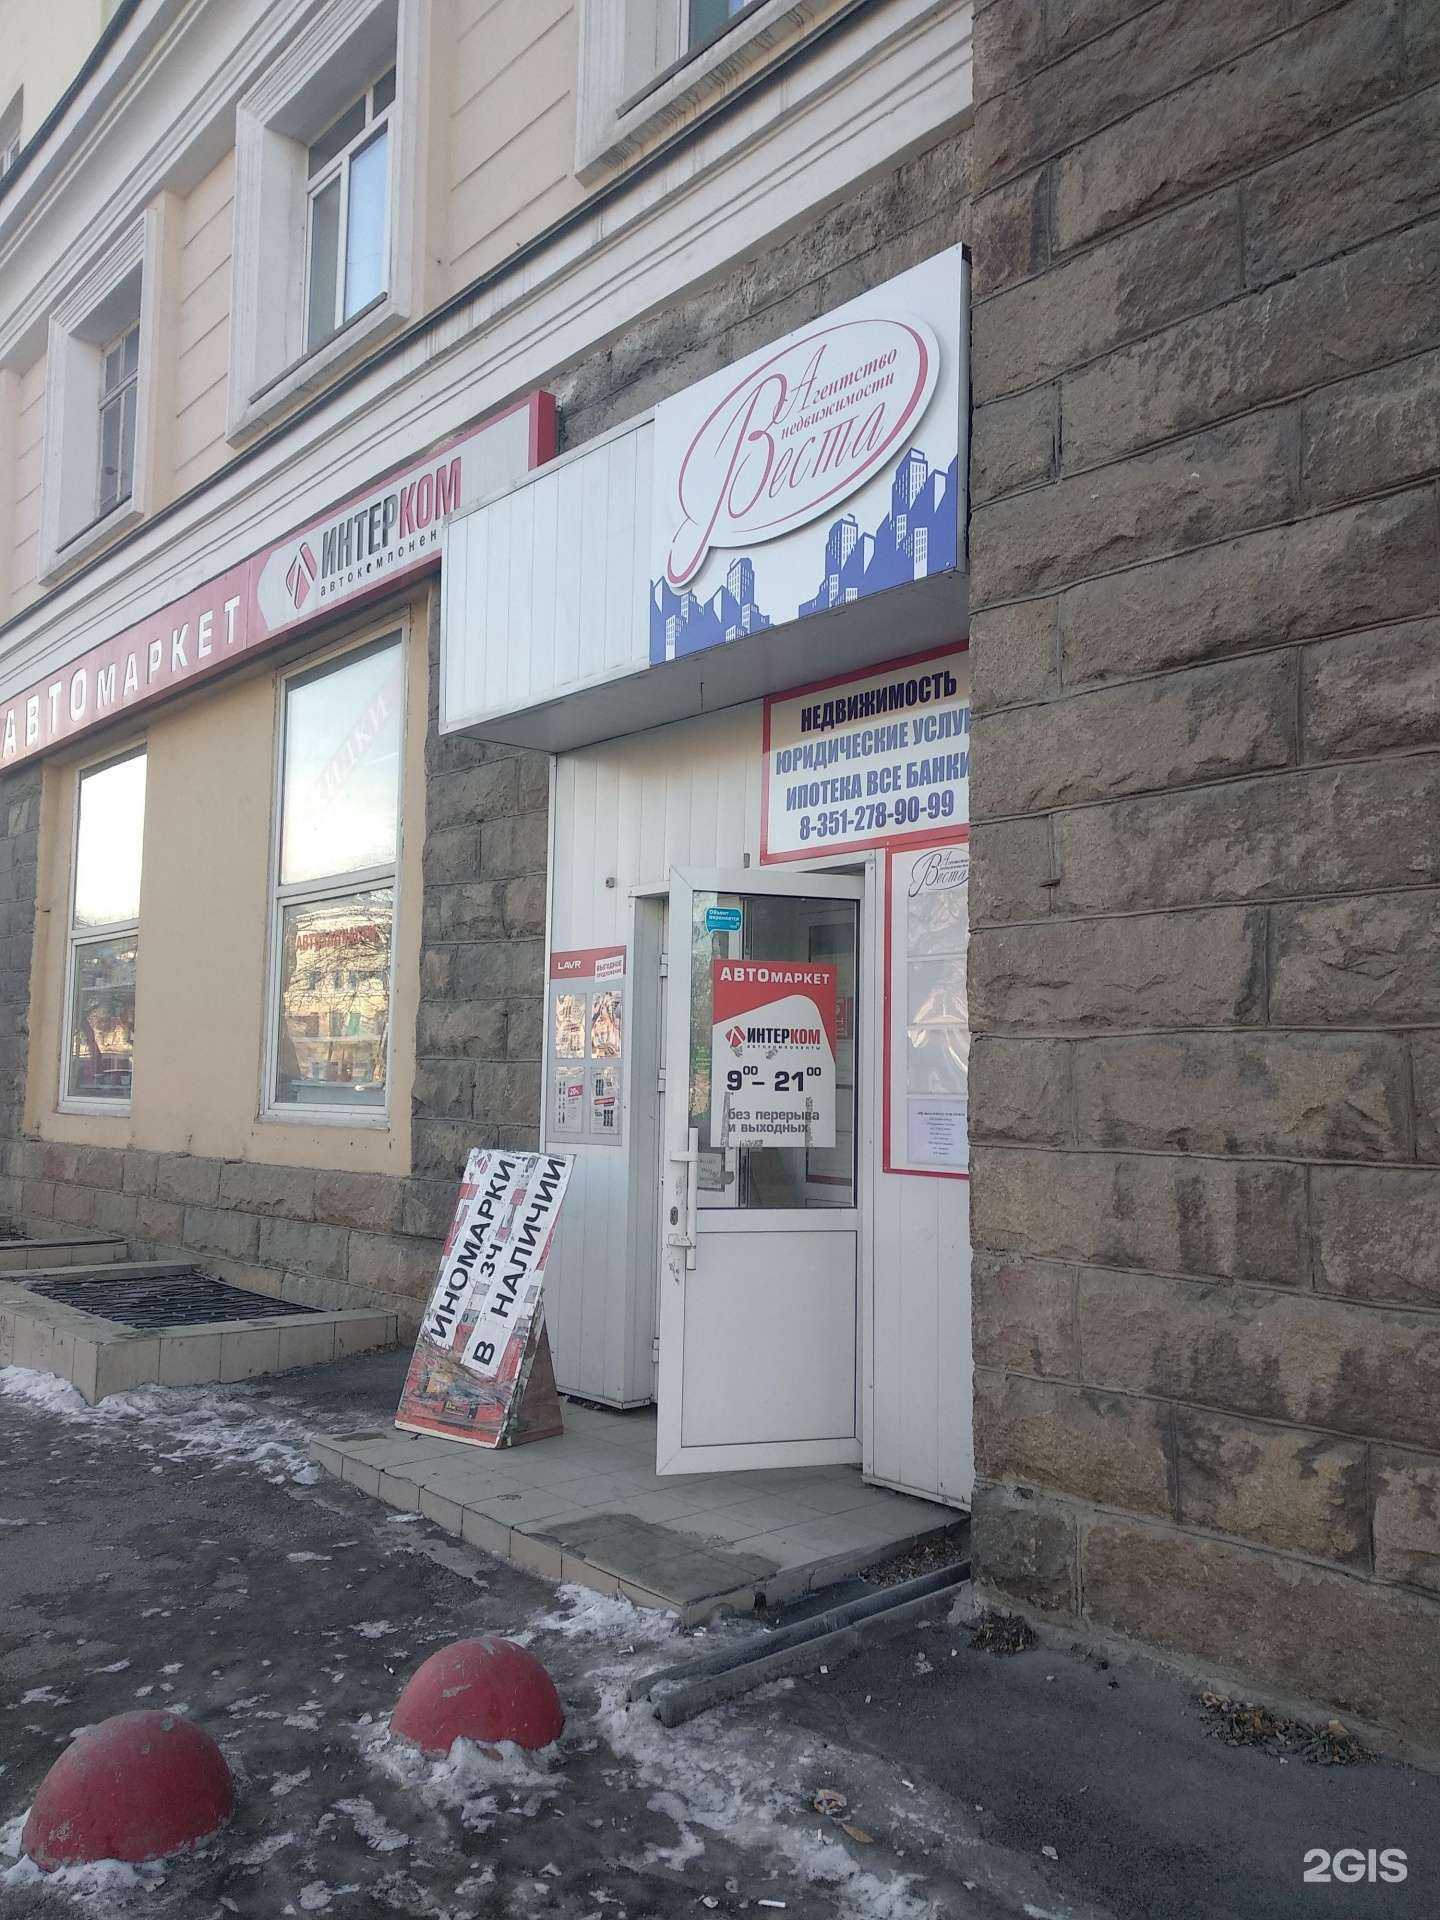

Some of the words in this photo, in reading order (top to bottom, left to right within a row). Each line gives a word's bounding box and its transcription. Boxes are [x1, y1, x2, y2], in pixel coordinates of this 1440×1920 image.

[775, 343, 897, 425] Агентство
[780, 371, 895, 441] недвижимости
[667, 373, 886, 585] Веста
[321, 456, 462, 579] ИНТЕРКОМ
[1, 595, 240, 758] АВТОМАРКЕТ
[801, 670, 957, 733] НЕДВИЖИМОСТЬ
[776, 721, 909, 775] ЮРИДИЧЕСКИЕ
[786, 773, 863, 812] ИПОТЕКА
[866, 765, 902, 795] ВСЕ
[906, 751, 970, 789] БАНКИ
[799, 789, 955, 841] 8-351-278-90-99
[557, 960, 582, 970] LAVR
[720, 967, 830, 985] АВТОМАРКЕТ
[747, 1027, 820, 1045] ИНТЕРКОМ
[728, 1108, 751, 1120] без
[755, 1110, 820, 1123] перерыва
[741, 1123, 808, 1135] выходных
[430, 1159, 517, 1340] ИНОМАРКИ
[472, 1340, 496, 1366] В
[490, 1158, 567, 1318] НАЛИЧИИ
